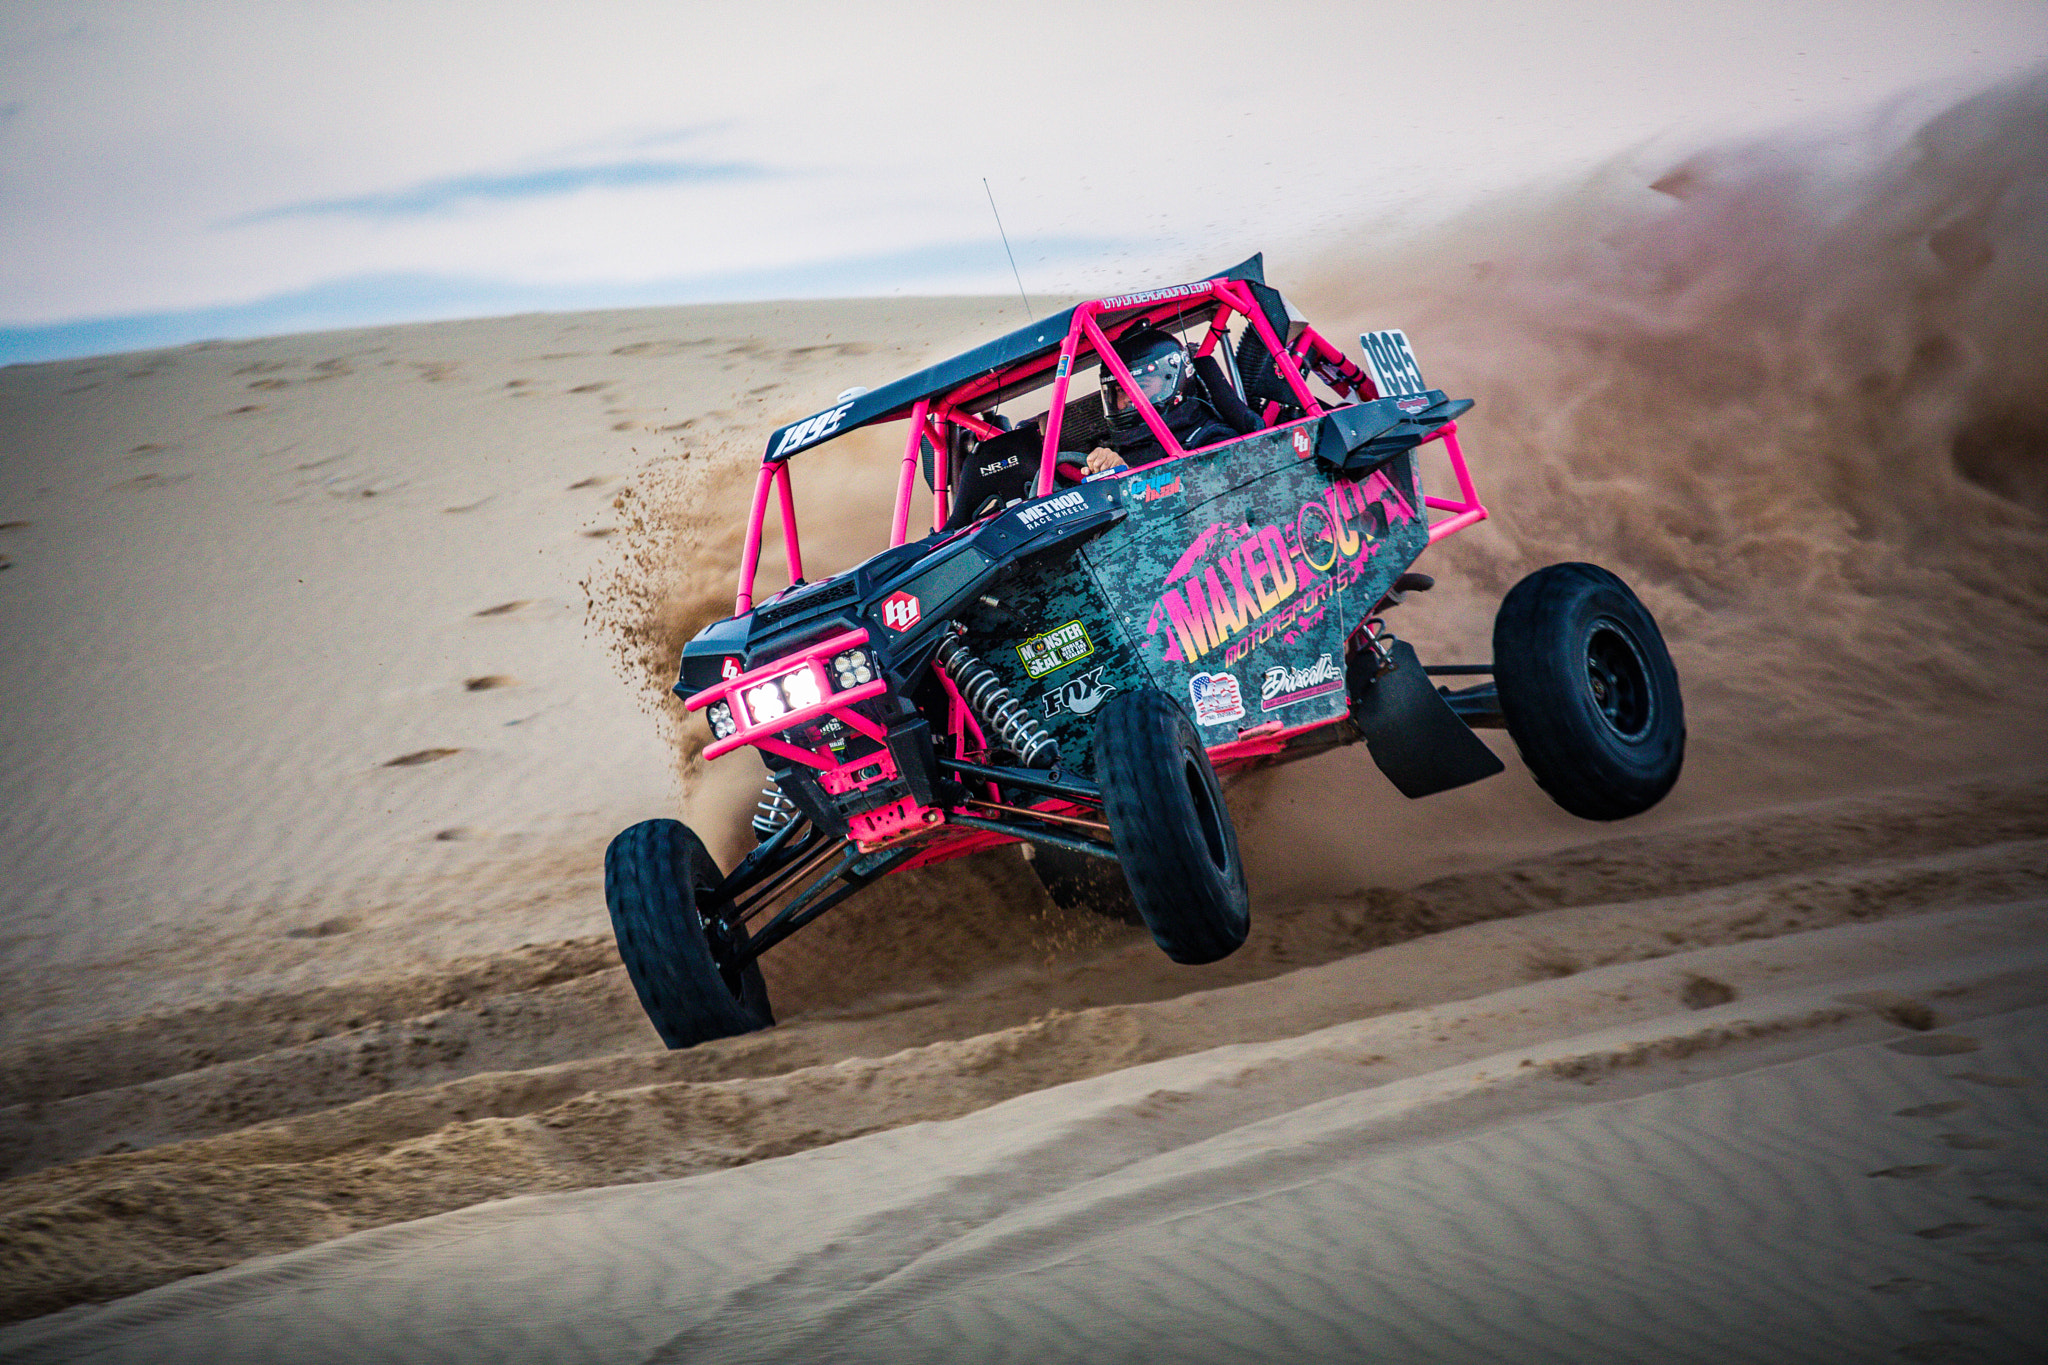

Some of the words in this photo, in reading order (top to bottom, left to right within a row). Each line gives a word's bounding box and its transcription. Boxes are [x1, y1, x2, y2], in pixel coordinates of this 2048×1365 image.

[1360, 331, 1426, 396] 1995
[1016, 491, 1085, 526] METHOD
[1026, 515, 1053, 531] RACE
[1053, 502, 1089, 519] WHEELS
[1225, 569, 1349, 669] MOTORSPORTS
[1030, 650, 1062, 676] SEAL
[1042, 665, 1105, 718] FOX
